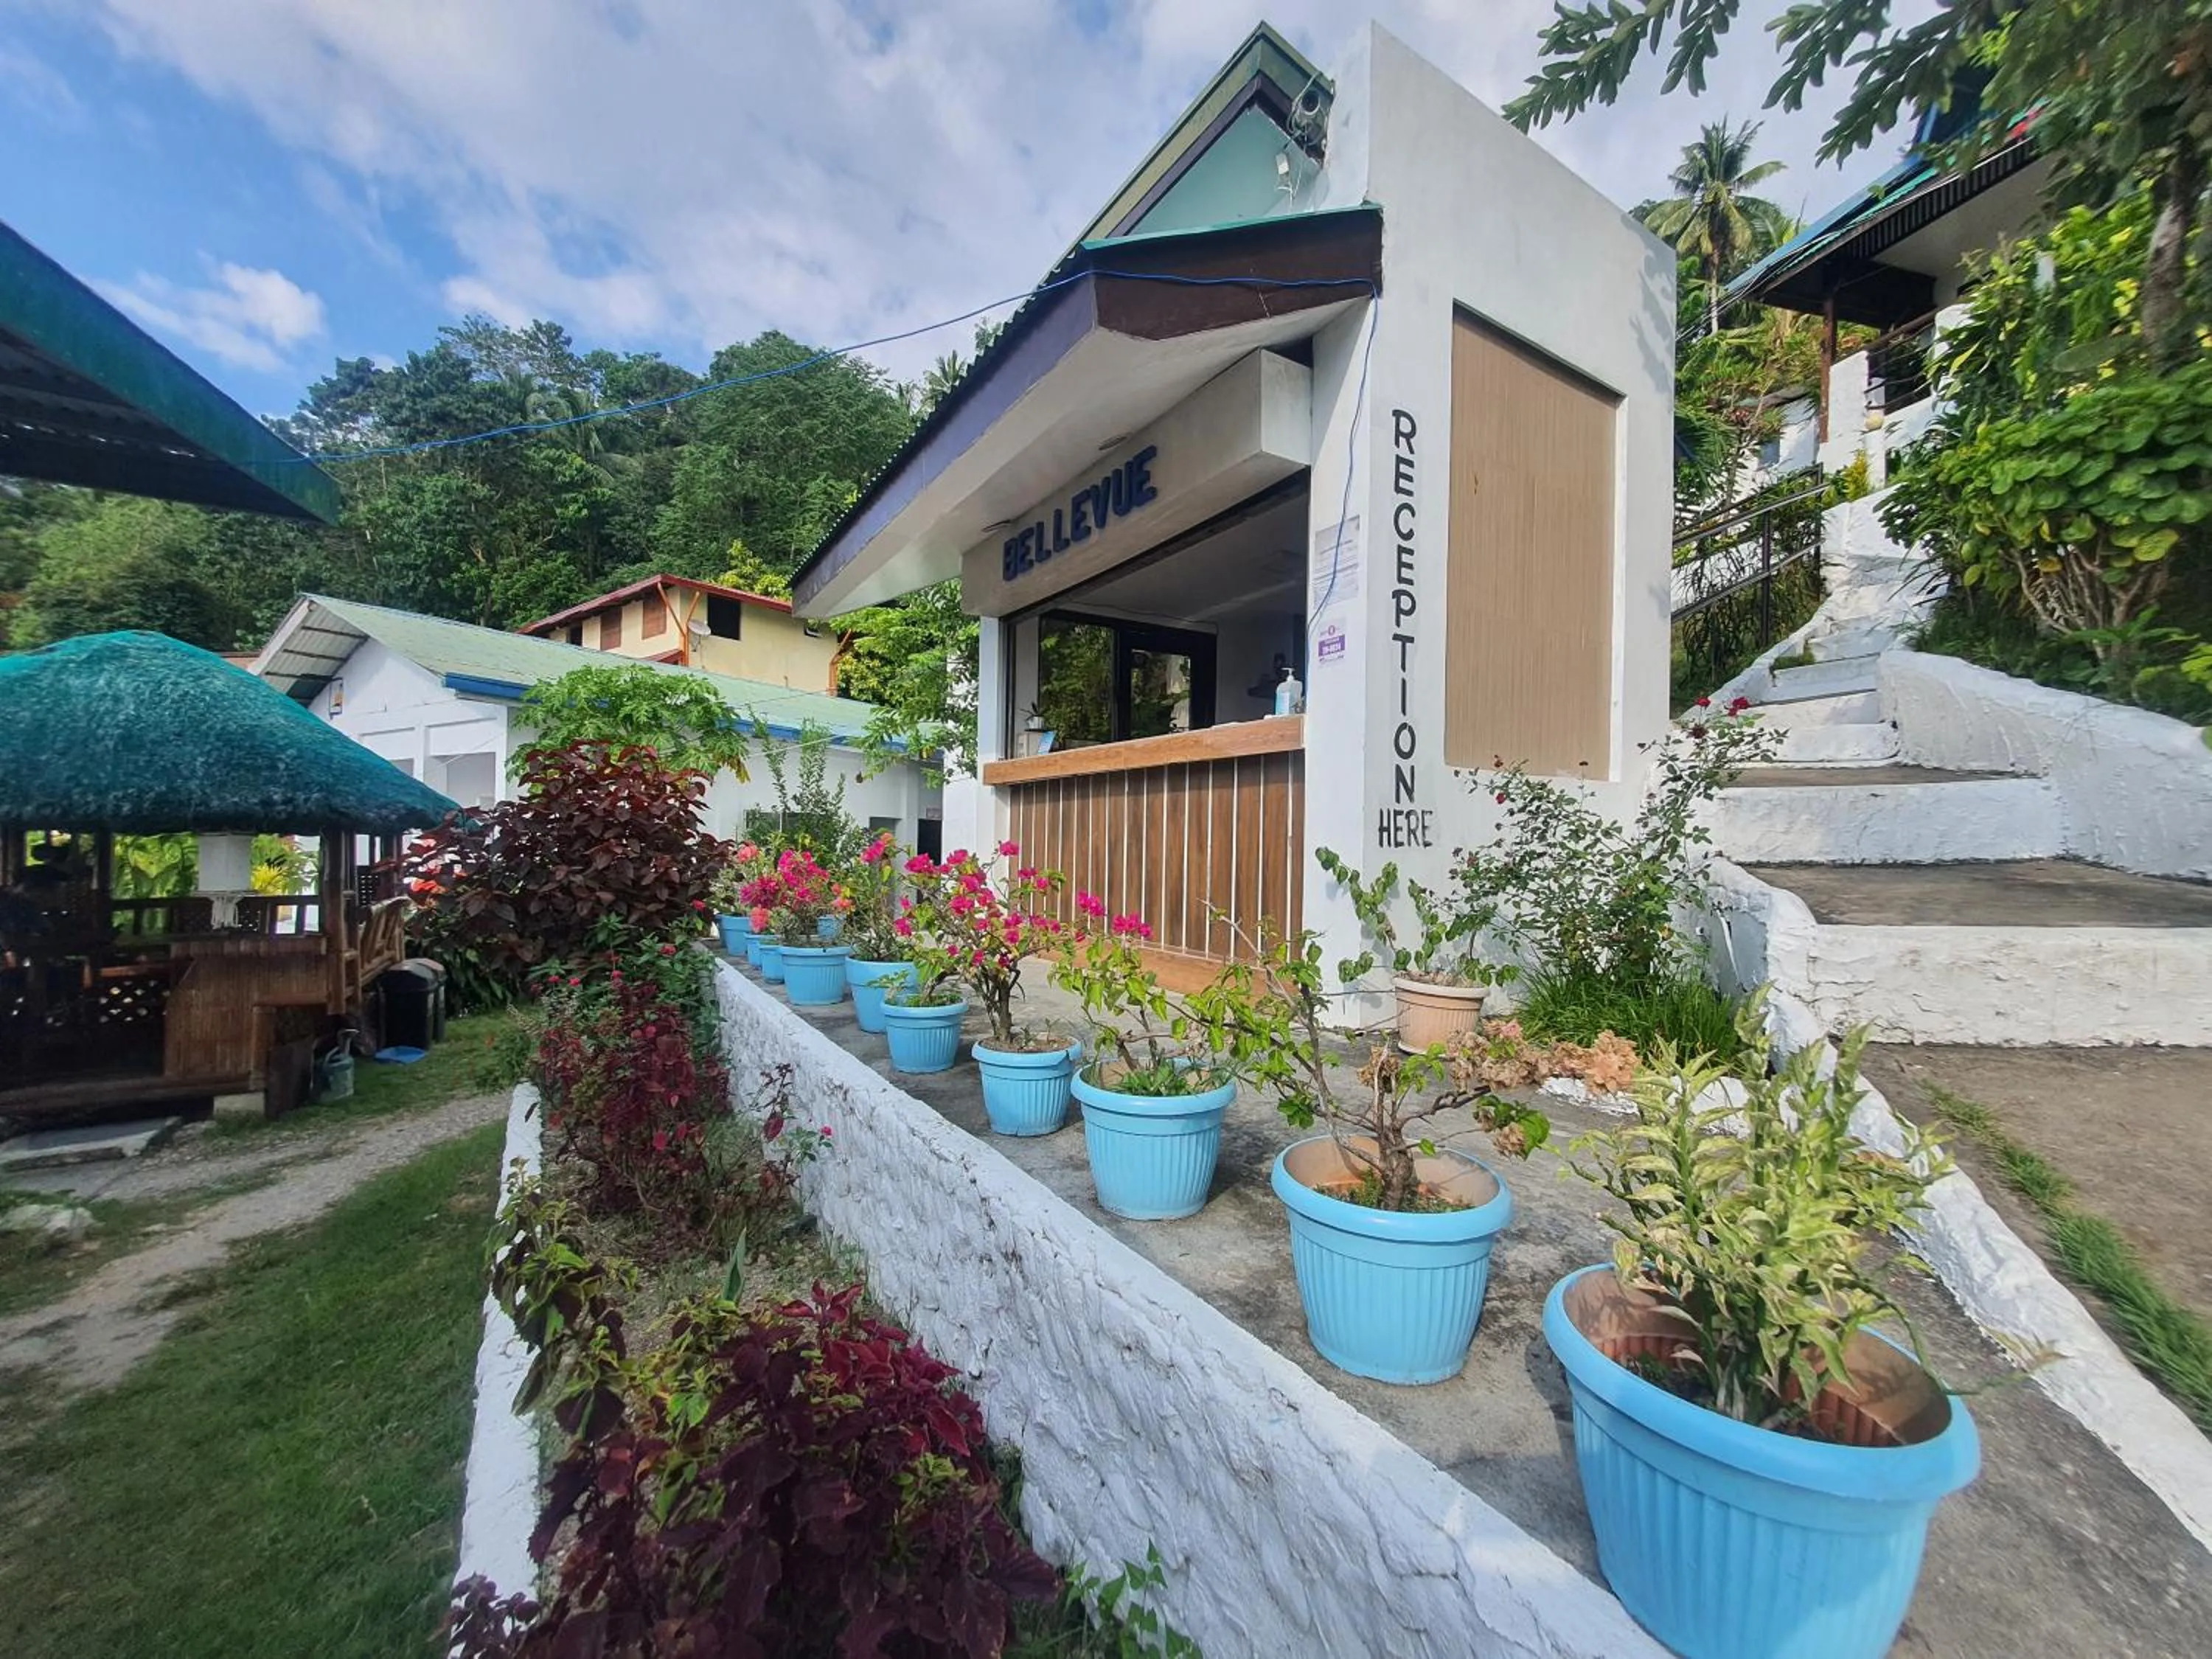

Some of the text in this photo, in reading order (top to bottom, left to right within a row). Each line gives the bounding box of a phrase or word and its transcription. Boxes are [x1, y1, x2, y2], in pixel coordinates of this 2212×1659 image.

[1003, 445, 1158, 581] BELLEVUE
[1392, 409, 1416, 804] RECEPTION
[1378, 808, 1433, 848] HERE
